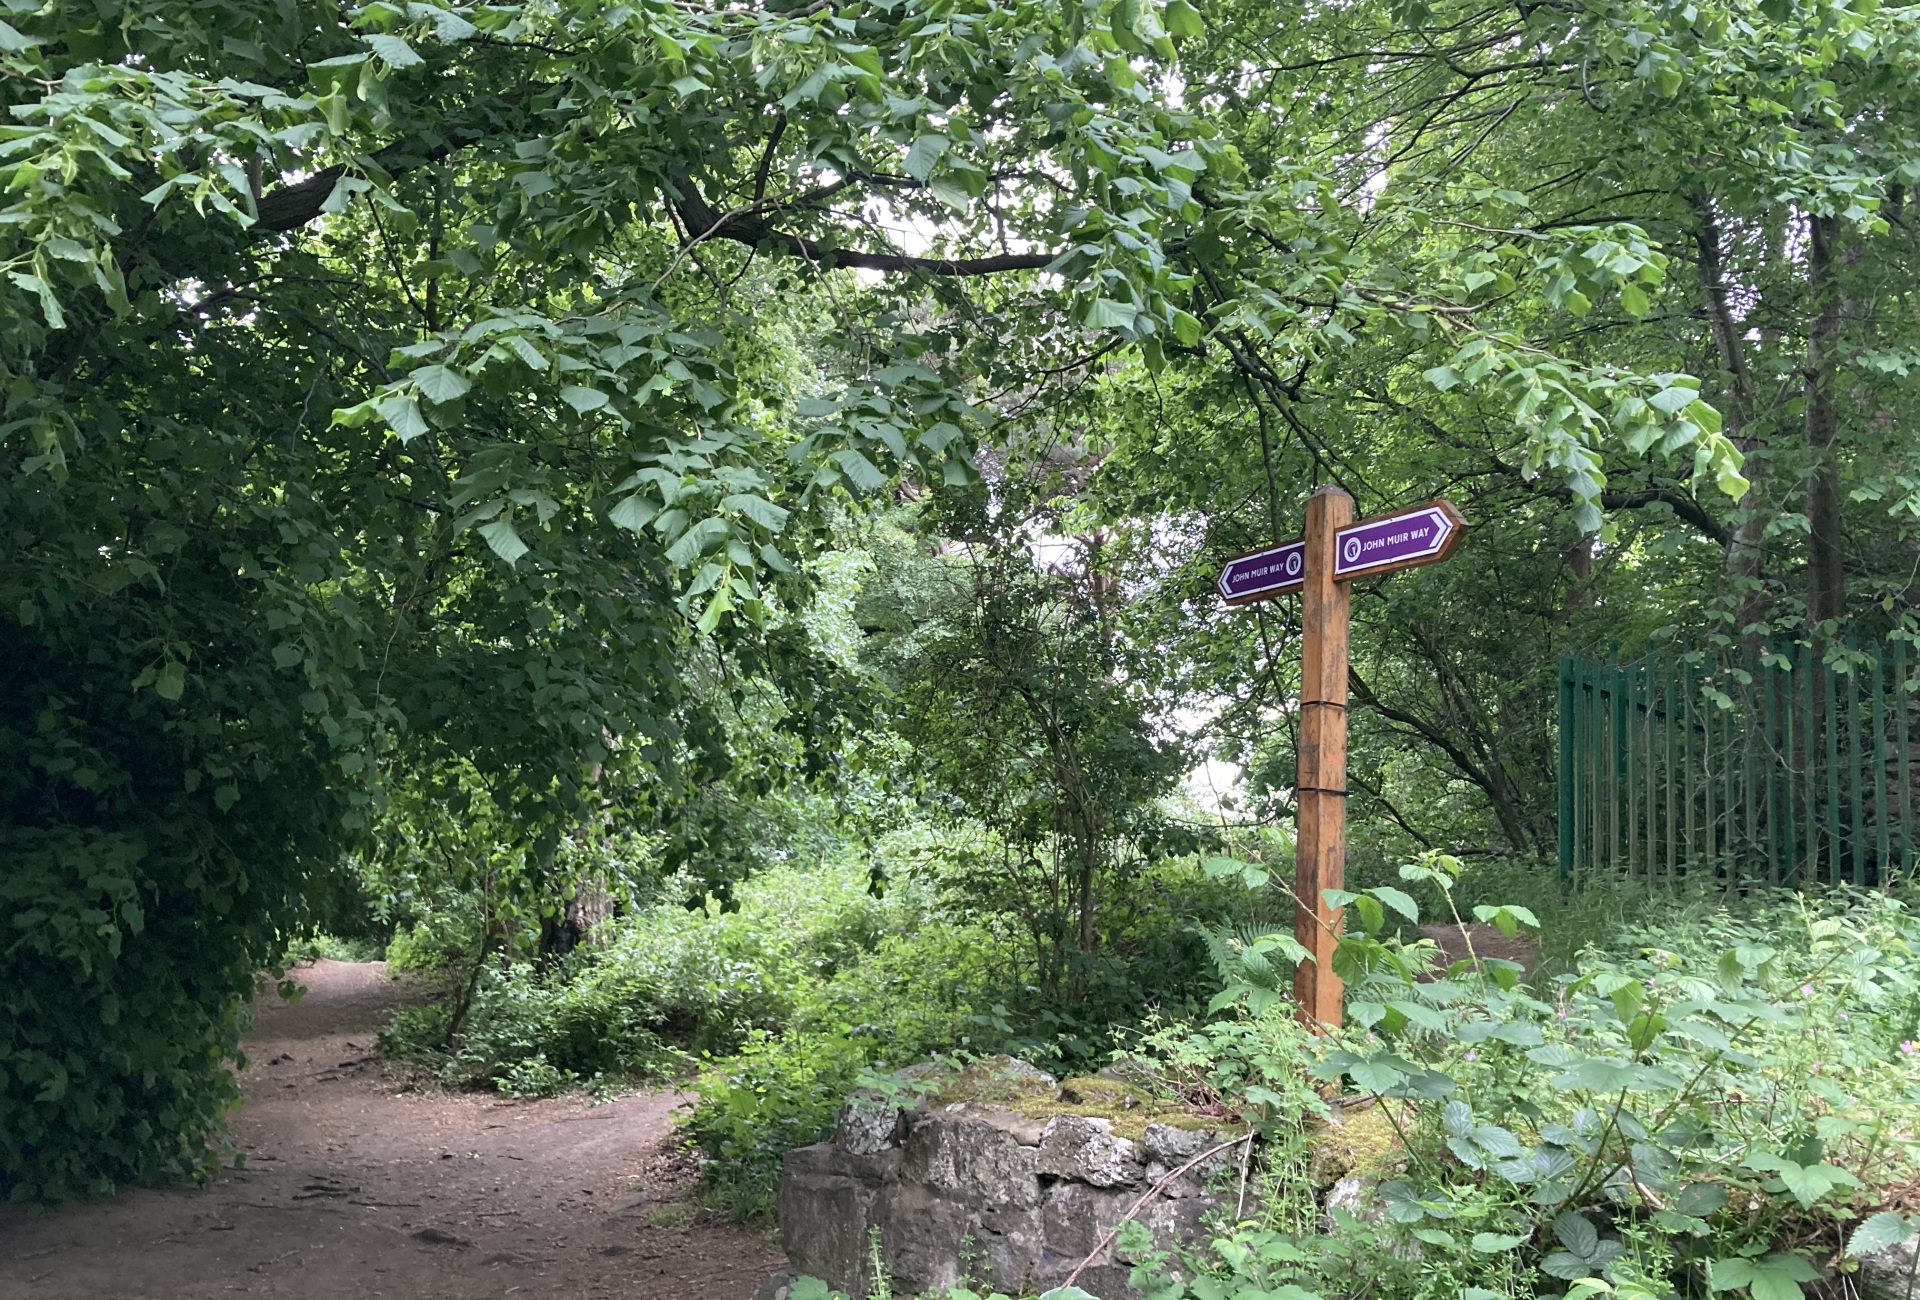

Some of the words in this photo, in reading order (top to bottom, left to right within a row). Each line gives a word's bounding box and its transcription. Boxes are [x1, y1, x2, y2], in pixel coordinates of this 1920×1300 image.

[1362, 538, 1385, 552] JOHN
[1387, 532, 1409, 547] MUIR
[1410, 527, 1430, 541] WAY
[1232, 571, 1250, 583] JOHN
[1251, 566, 1268, 578] MUIR
[1269, 562, 1284, 573] WAY
